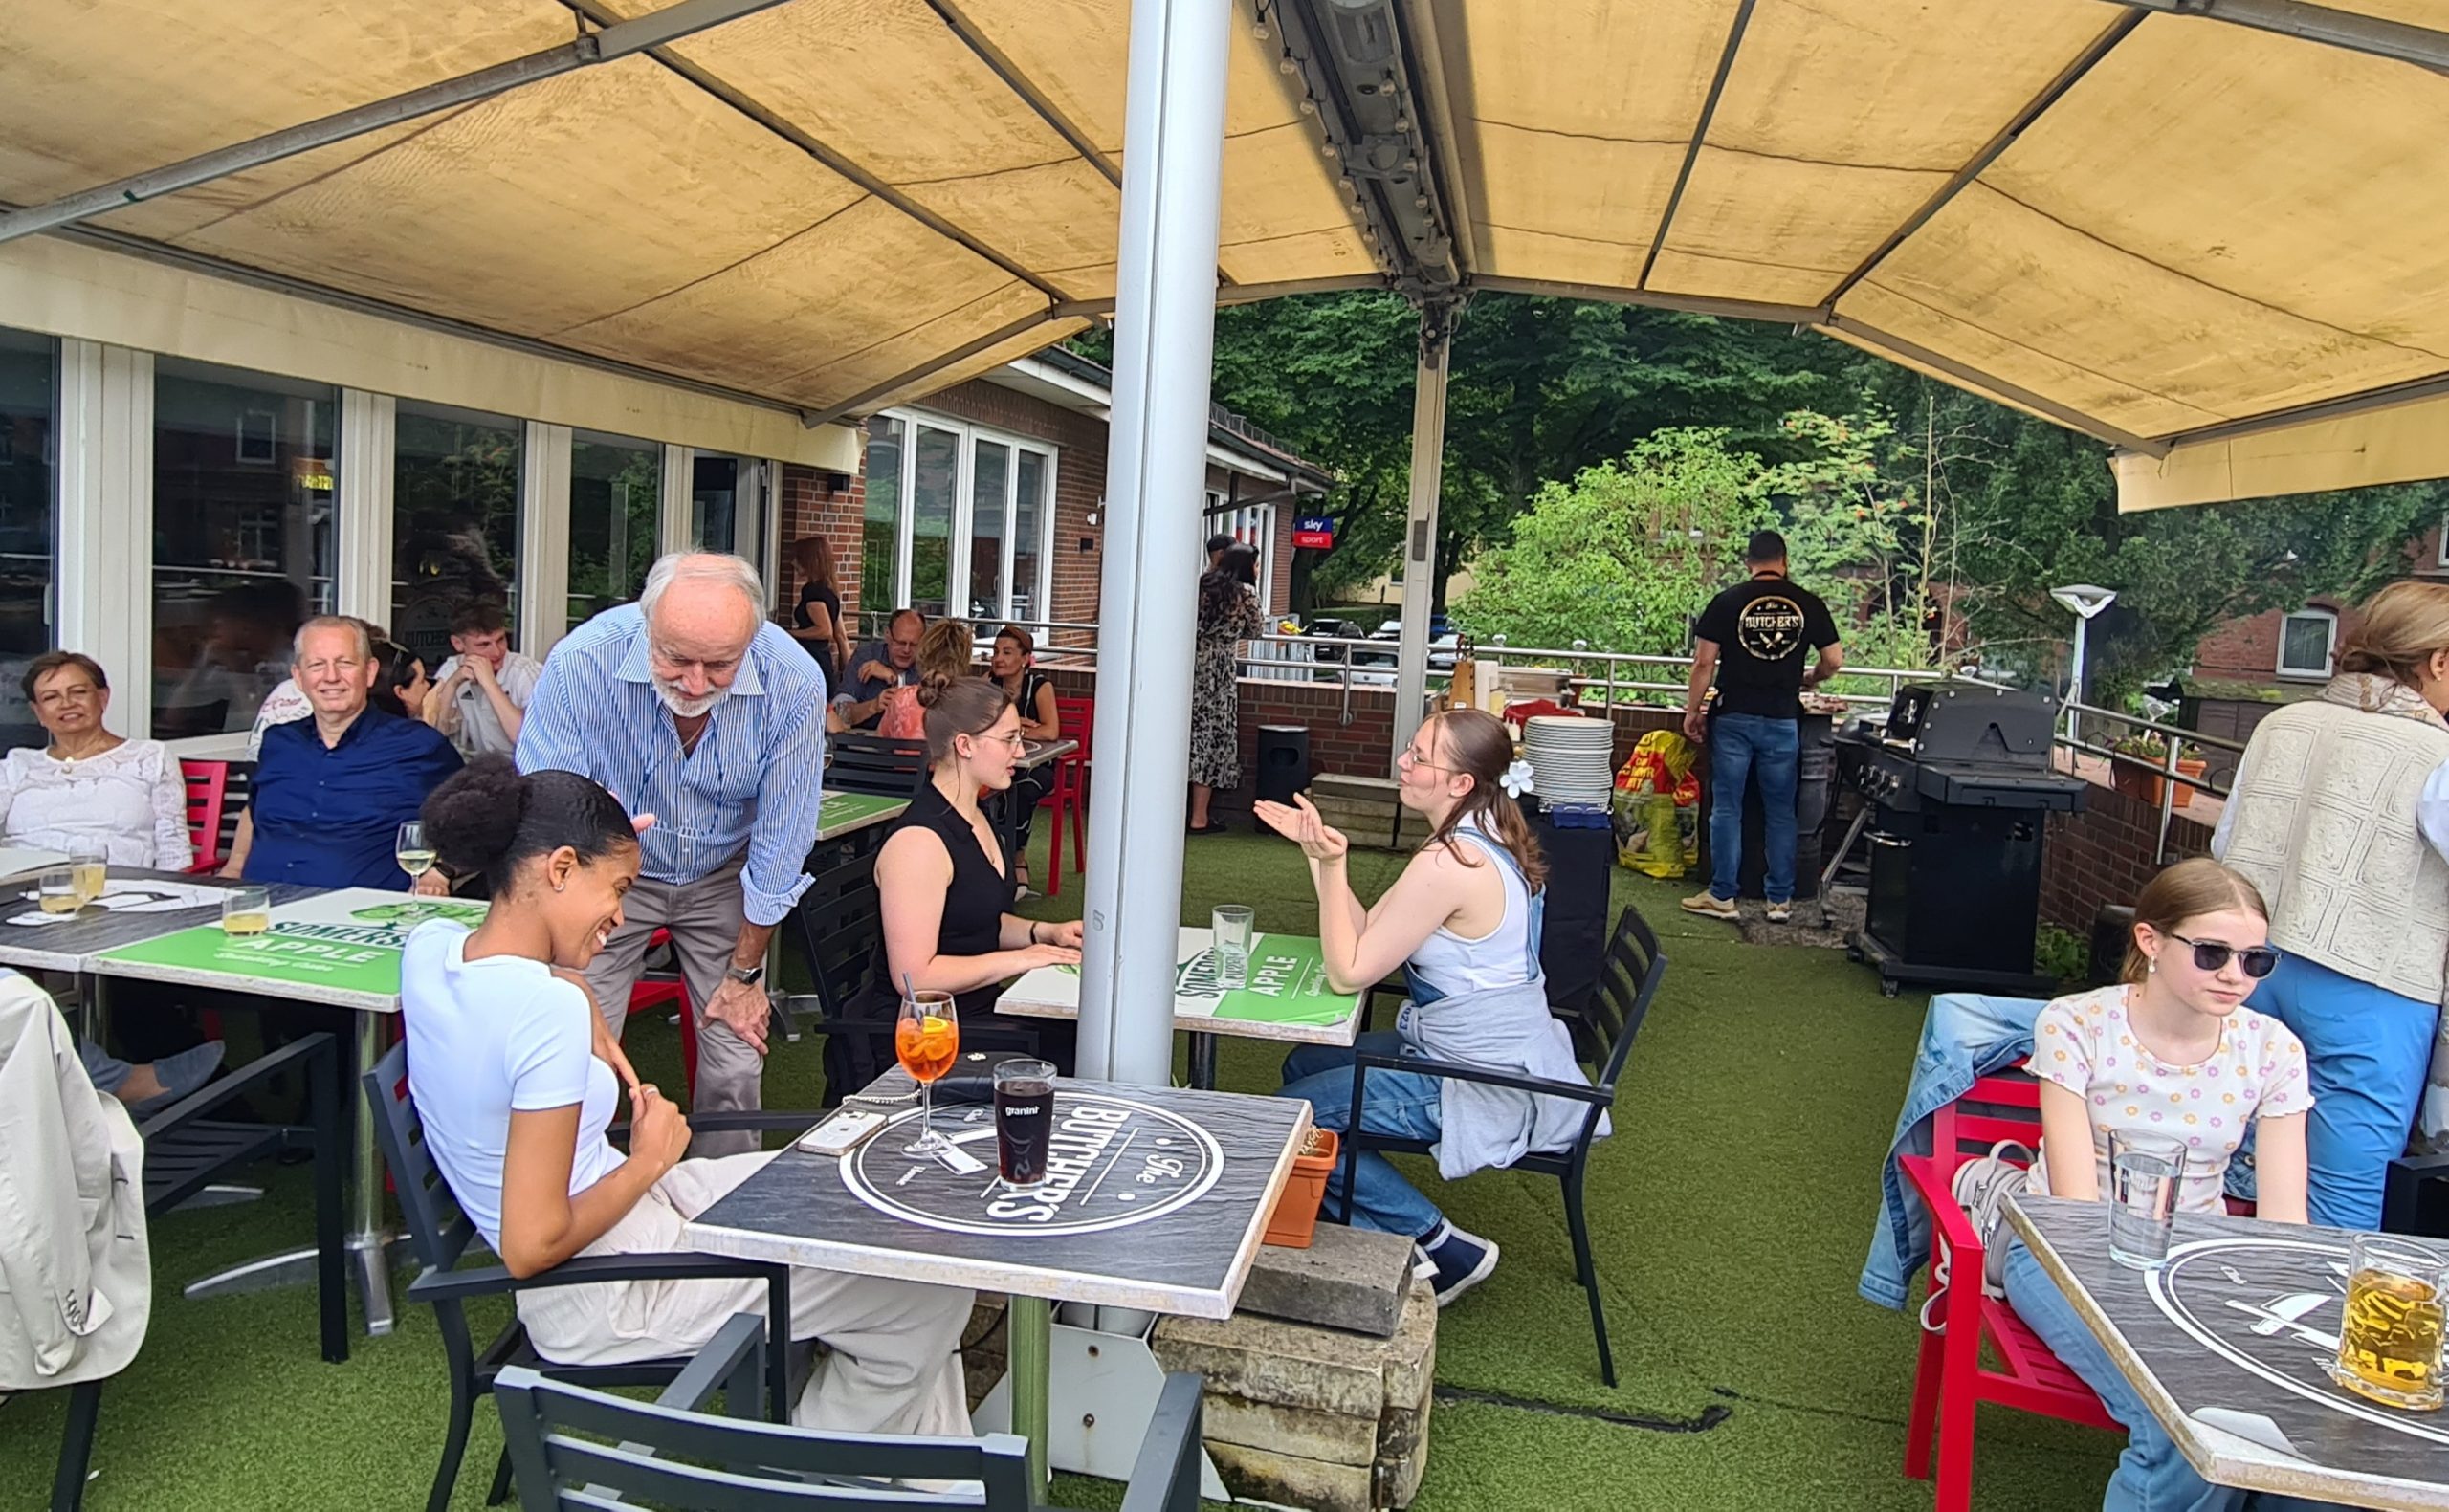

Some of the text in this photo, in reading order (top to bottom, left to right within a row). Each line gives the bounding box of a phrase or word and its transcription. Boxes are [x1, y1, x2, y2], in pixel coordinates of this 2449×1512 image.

[1304, 518, 1323, 532] sky
[271, 921, 408, 948] SOMERS
[235, 938, 386, 963] APPLE
[1248, 955, 1298, 997] APPLE
[1004, 1106, 1040, 1117] granini
[1135, 1153, 1184, 1186] The
